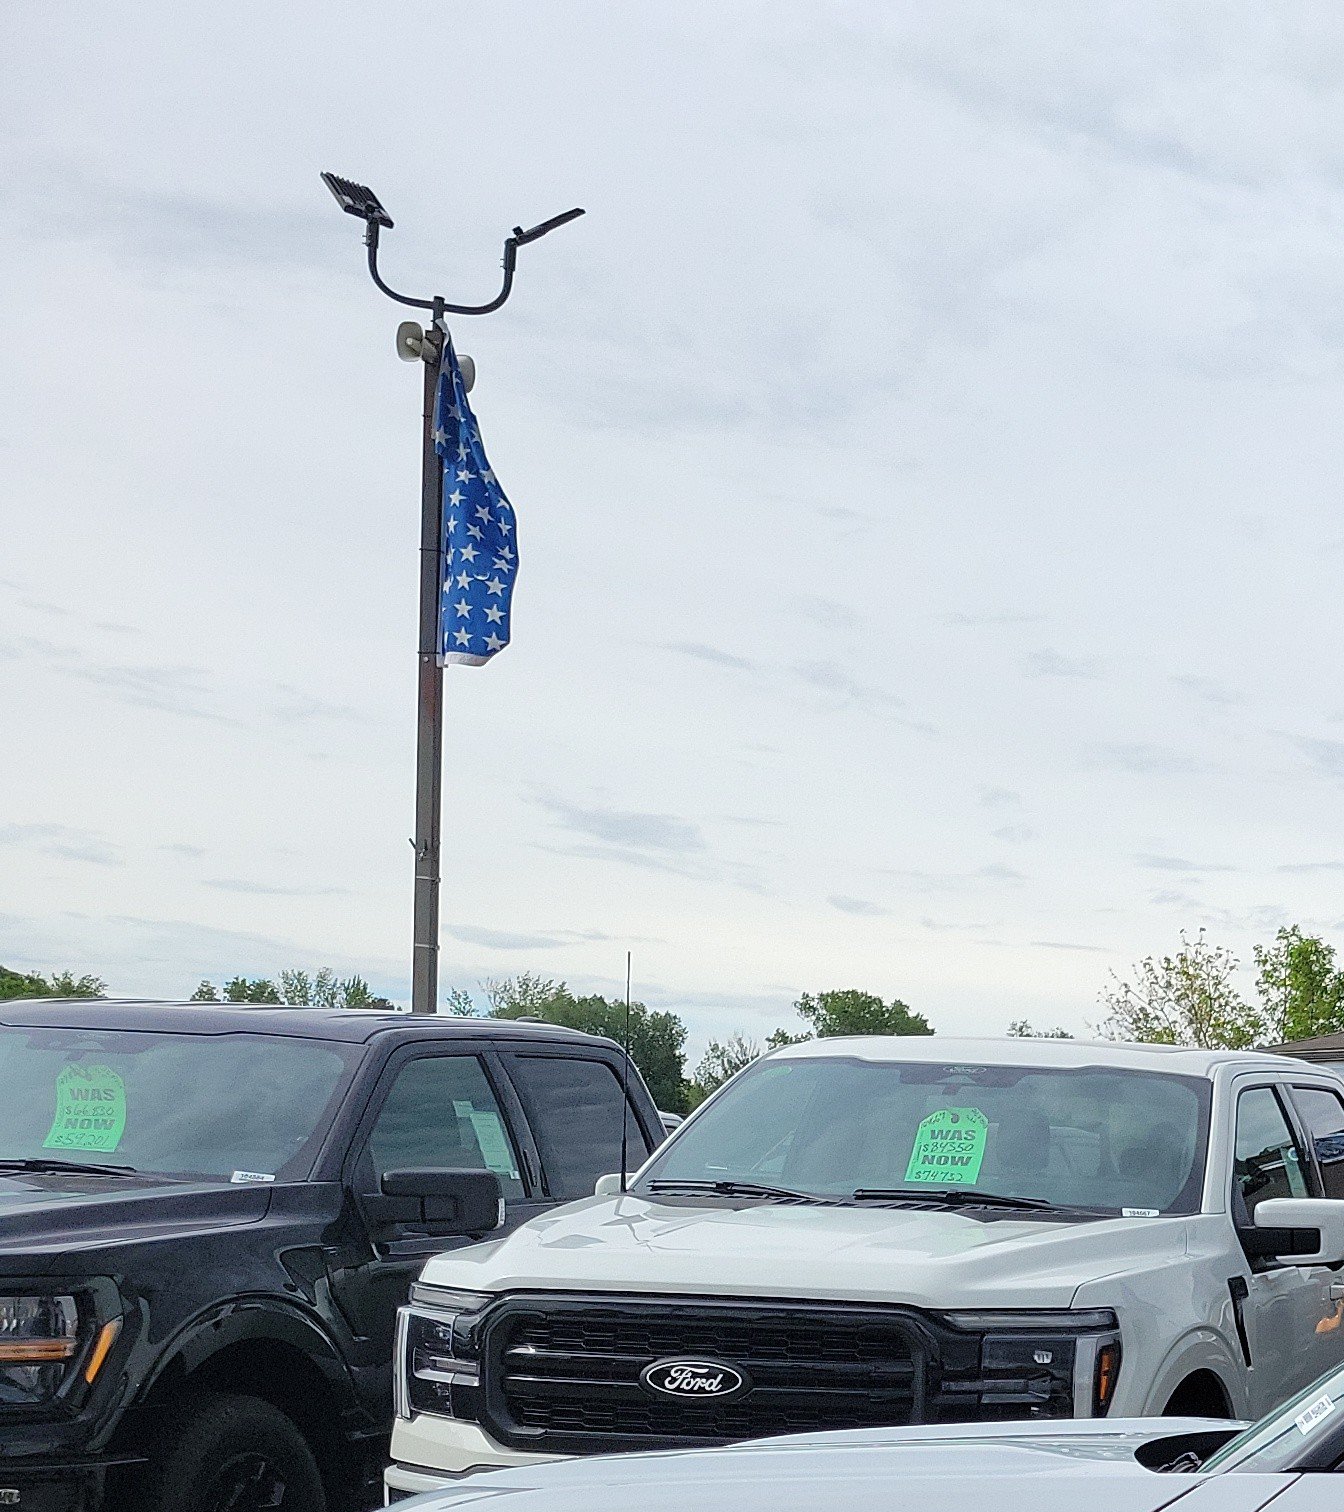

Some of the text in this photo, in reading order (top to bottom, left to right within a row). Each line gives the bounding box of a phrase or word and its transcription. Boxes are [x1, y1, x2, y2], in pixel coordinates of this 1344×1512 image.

[70, 1088, 115, 1101] WAS
[64, 1118, 115, 1130] NOW
[930, 1129, 976, 1141] WAS
[921, 1154, 973, 1167] NOW
[664, 1365, 723, 1391] Ford
